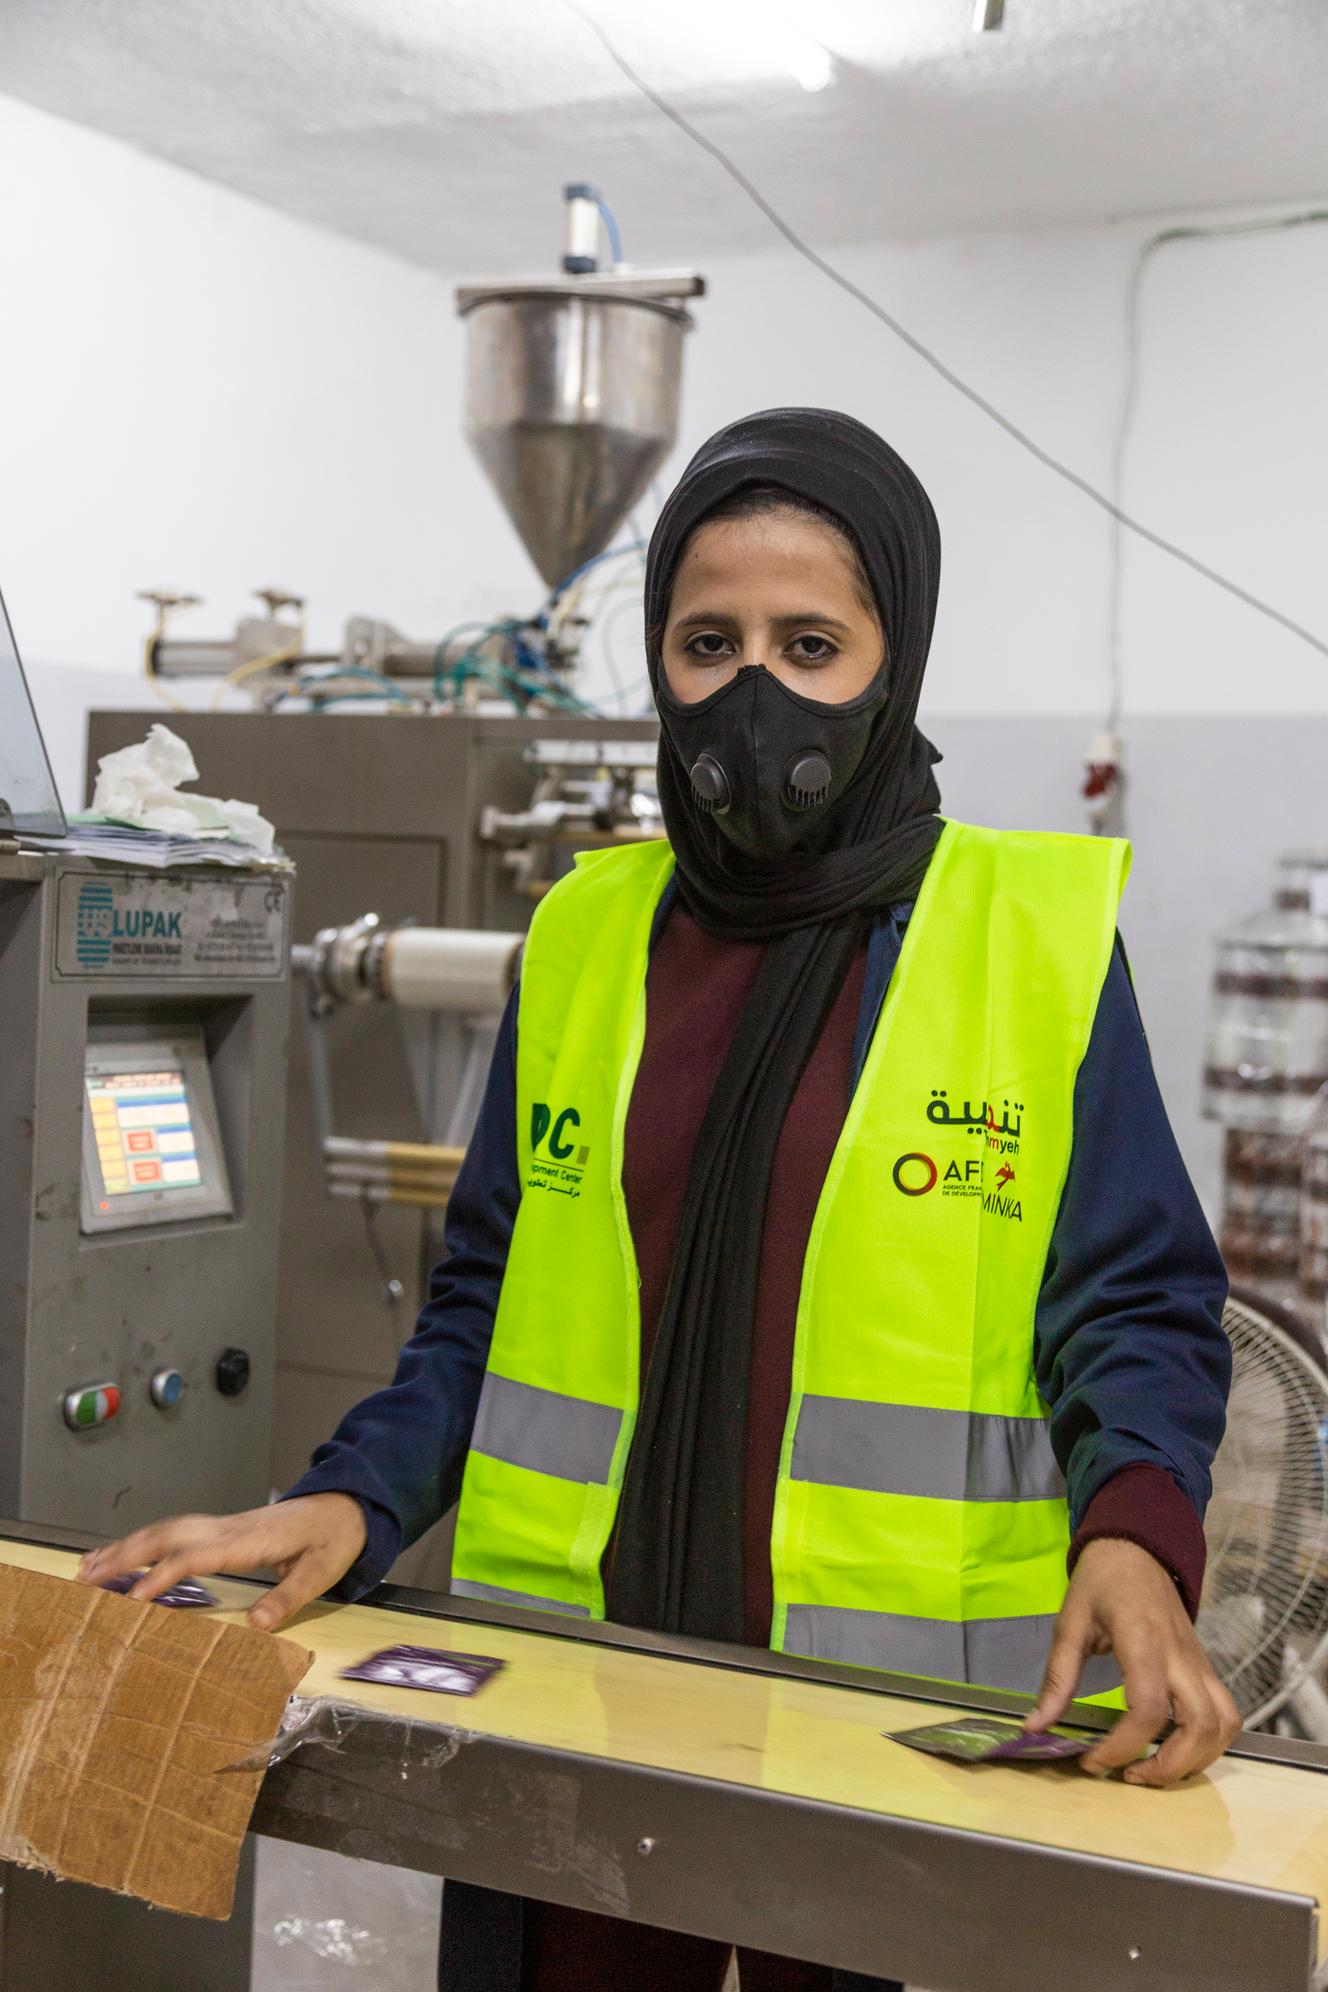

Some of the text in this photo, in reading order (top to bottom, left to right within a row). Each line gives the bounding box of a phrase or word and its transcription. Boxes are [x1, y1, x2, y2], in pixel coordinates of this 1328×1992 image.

[112, 910, 182, 938] LUPAK
[926, 1089, 1025, 1138] تنمية
[986, 1136, 1020, 1156] myeh
[943, 1160, 984, 1183] AF
